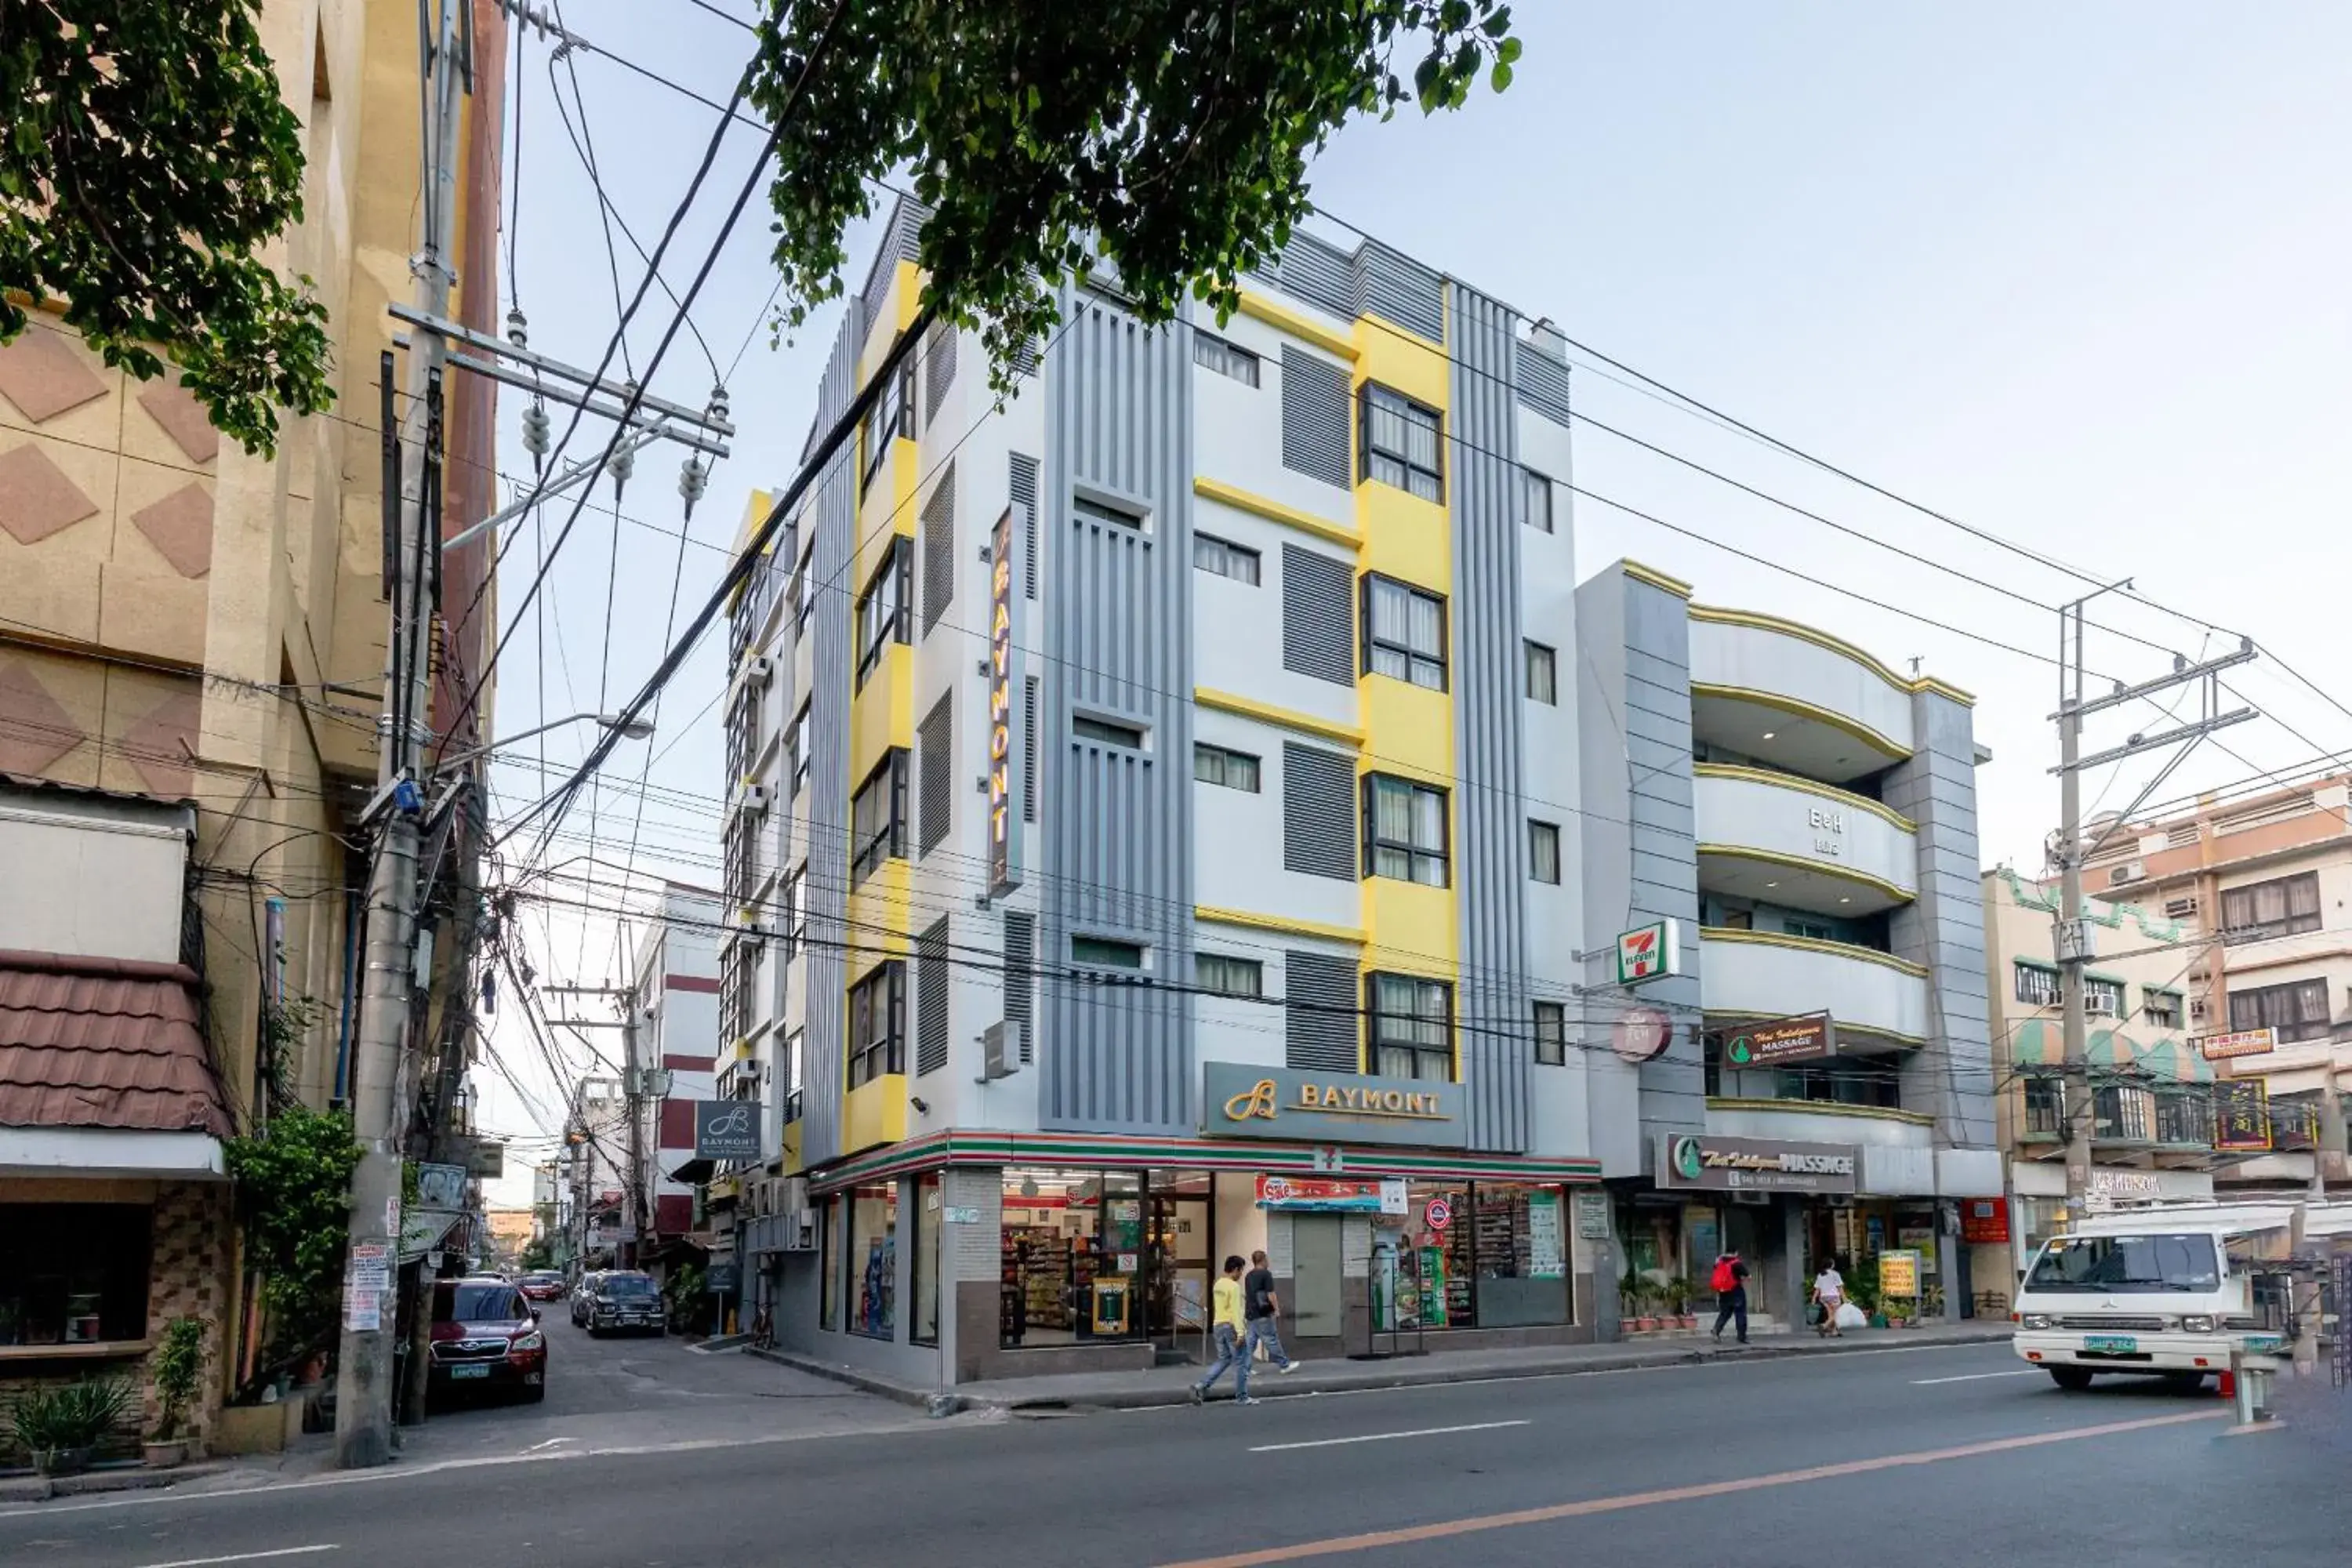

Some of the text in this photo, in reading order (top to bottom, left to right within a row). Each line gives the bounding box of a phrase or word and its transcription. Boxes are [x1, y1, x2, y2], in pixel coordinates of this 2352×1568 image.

[991, 559, 1010, 843] BAYMONT
[1626, 930, 1655, 976] 7
[1761, 1036, 1813, 1052] MASSAGE
[1301, 1083, 1439, 1114] BAYMONT
[701, 1137, 756, 1145] BAYMONT
[1778, 1153, 1854, 1174] MASSAGE
